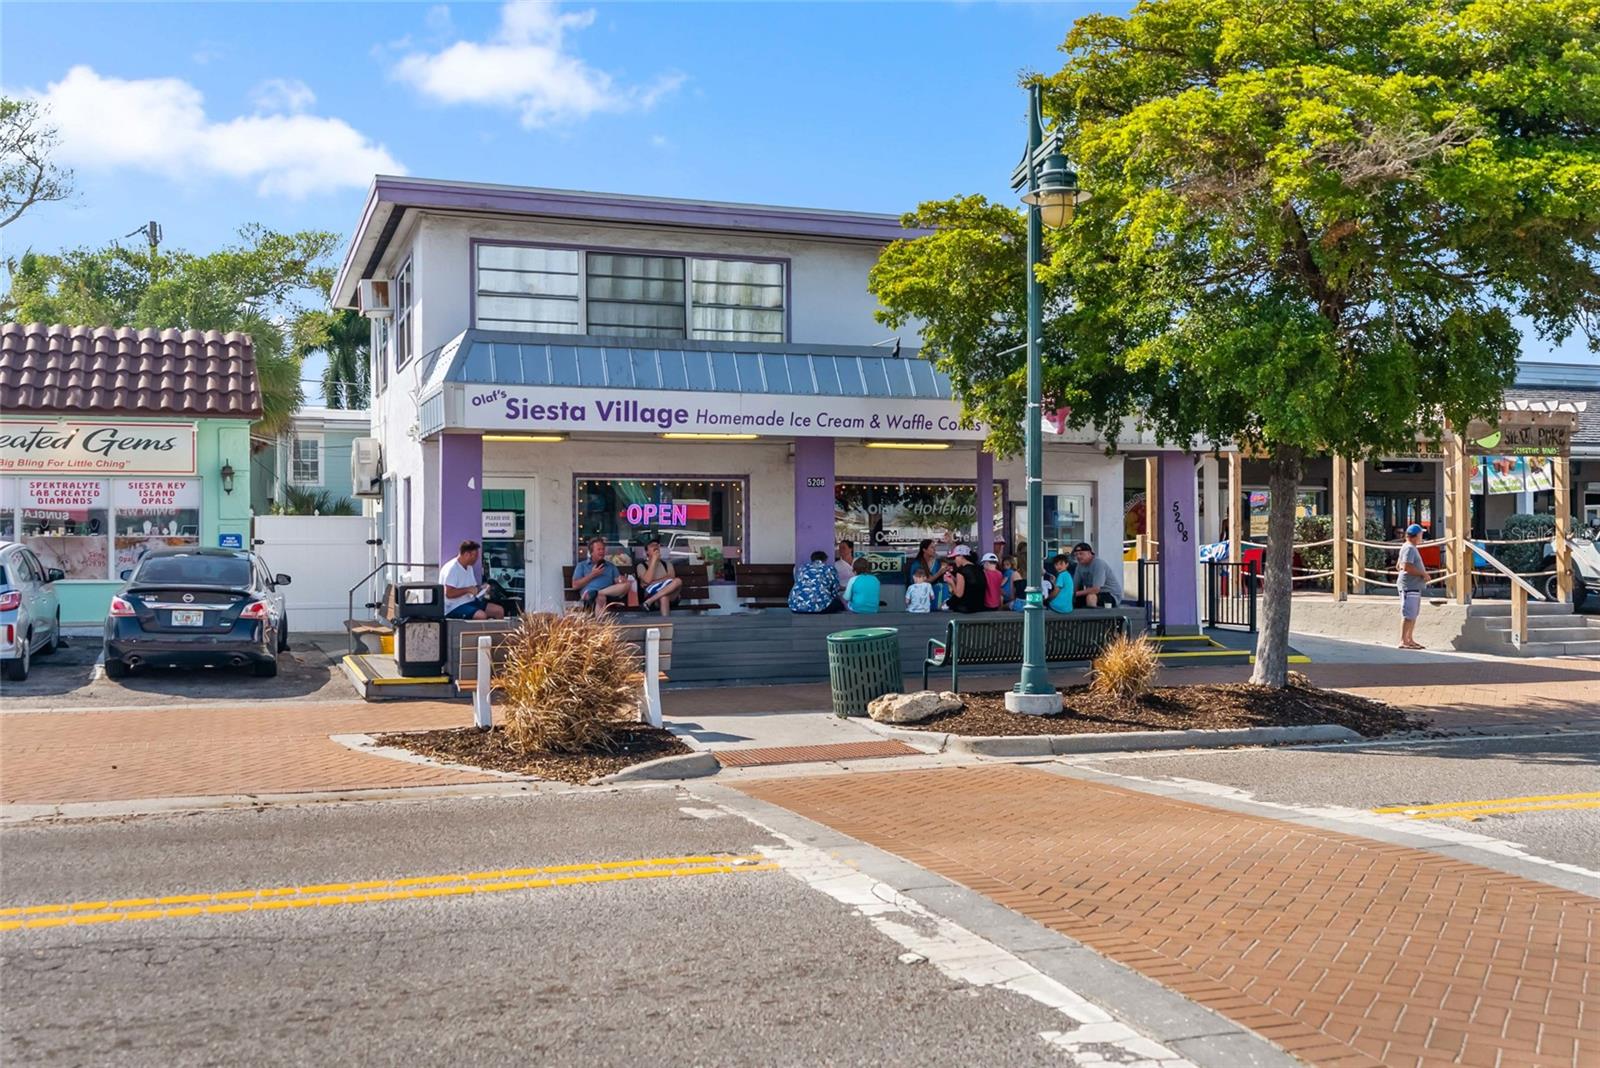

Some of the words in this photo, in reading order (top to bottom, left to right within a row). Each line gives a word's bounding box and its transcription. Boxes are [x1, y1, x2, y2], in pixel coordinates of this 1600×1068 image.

[471, 389, 507, 407] Olaf's
[505, 398, 585, 421] Siesta
[595, 400, 689, 429] Village
[696, 409, 784, 426] Homemade
[790, 411, 811, 427] Ice
[816, 412, 865, 429] Cream
[869, 414, 881, 429] &
[885, 414, 933, 431] Waffle
[82, 428, 177, 457] Gems
[17, 458, 44, 468] Bling
[48, 459, 65, 467] For
[67, 459, 93, 468] Little
[29, 481, 101, 489] SPEKTRALYTE
[807, 478, 825, 487] 5208
[30, 489, 50, 497] LAB
[37, 497, 93, 505] DIAMONDS
[141, 497, 174, 505] OPALS
[626, 503, 688, 526] OPEN
[1172, 501, 1189, 542] 5208
[869, 561, 898, 572] DGE
